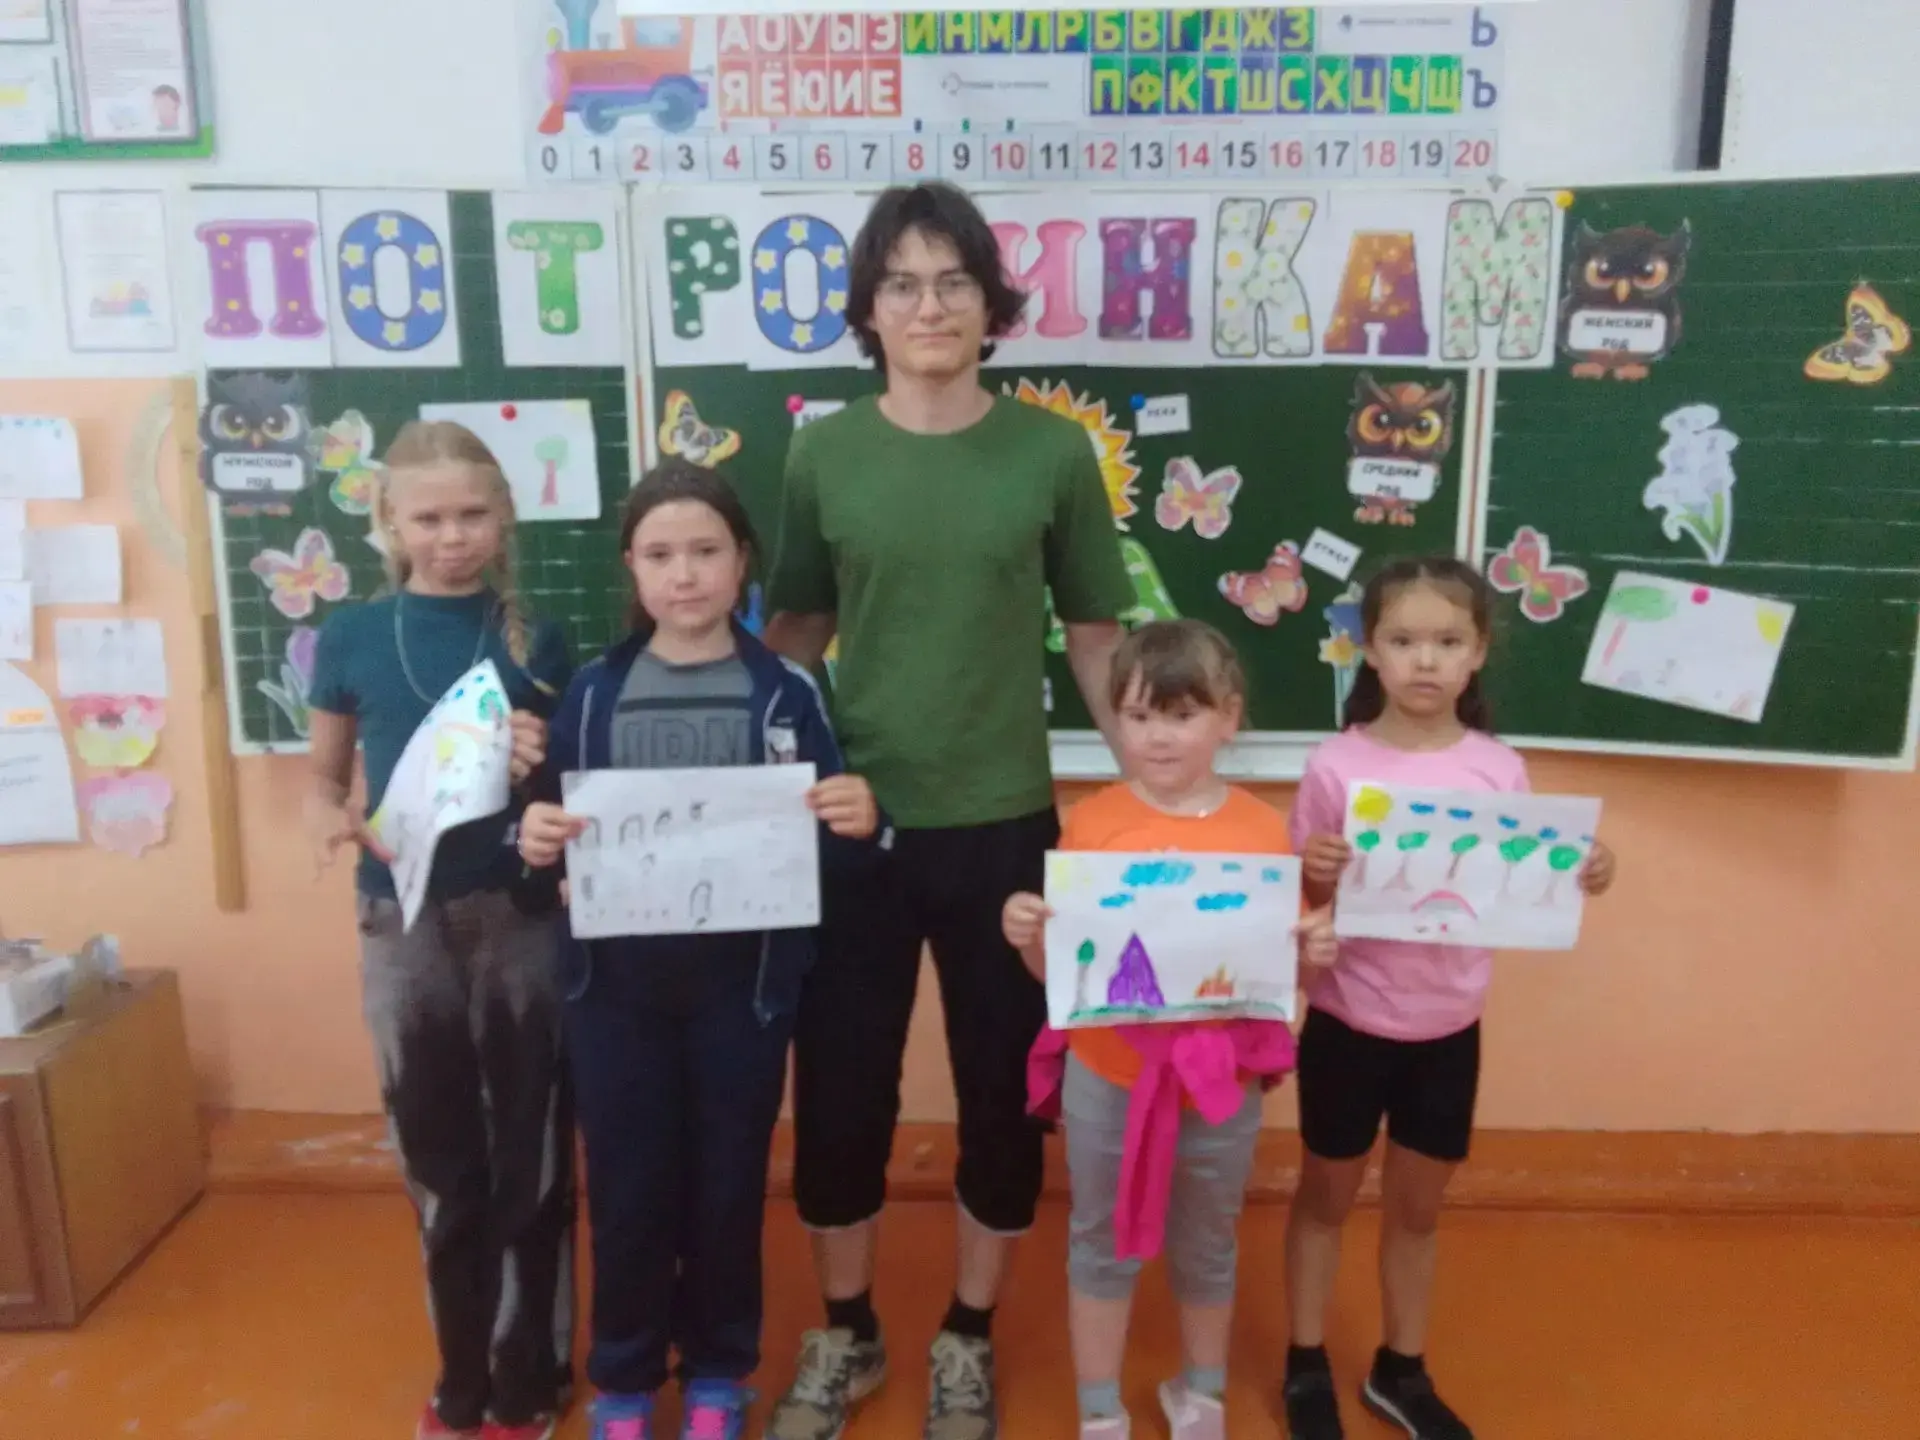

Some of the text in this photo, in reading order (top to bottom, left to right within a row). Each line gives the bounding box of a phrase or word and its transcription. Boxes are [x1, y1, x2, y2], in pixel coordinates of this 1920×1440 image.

[542, 140, 1490, 171] 0 1 2 3 4 5 6 7 8 9 10 11 12 13 14 15 16 17 18 19 20
